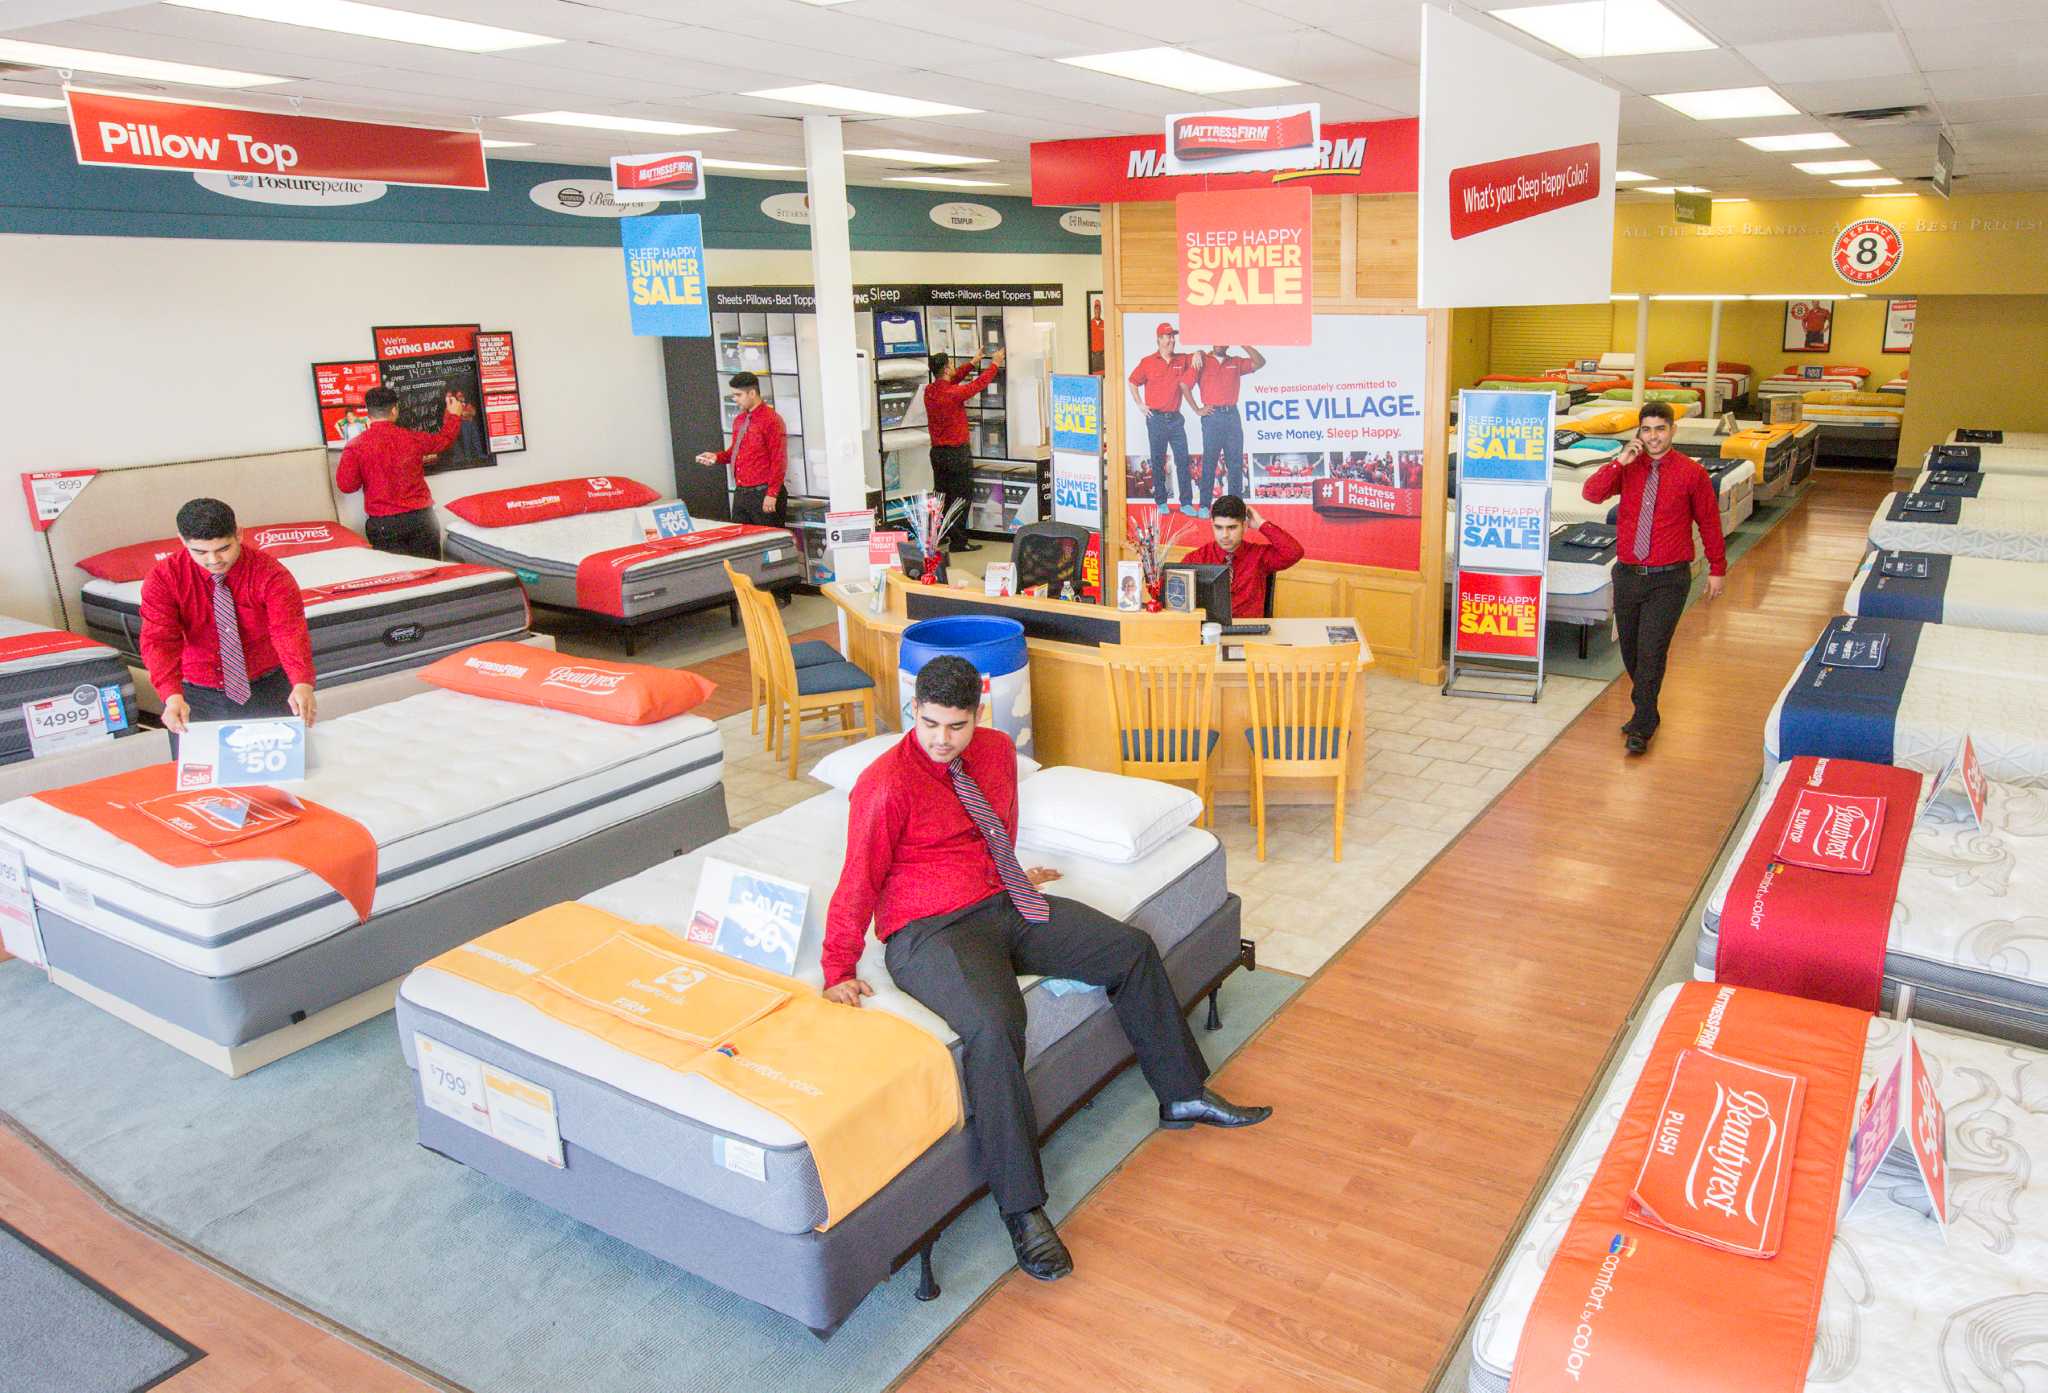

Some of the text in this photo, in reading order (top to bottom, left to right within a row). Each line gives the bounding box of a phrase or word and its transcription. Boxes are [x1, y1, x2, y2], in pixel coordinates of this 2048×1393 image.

[98, 120, 299, 171] Pillow Top
[1463, 162, 1589, 213] What's your Sleep Happy Color?
[1656, 224, 1687, 237] THE
[1695, 224, 1736, 236] BEST
[1743, 223, 1808, 236] BRANDS
[1915, 218, 1961, 232] BEST
[1186, 228, 1303, 248] SLEEP HAPPY
[1842, 225, 1895, 245] REPLACE
[628, 245, 697, 261] SLEEP HAPPY
[1186, 244, 1302, 269] SUMMER
[1855, 236, 1879, 265] 8
[630, 258, 700, 278] SUMMER
[1841, 263, 1882, 280] EVERY
[631, 276, 702, 306] SALE
[869, 287, 900, 302] Sleep
[931, 289, 955, 301] Sheets
[957, 289, 982, 301] Pillows
[984, 290, 1000, 301] Bed
[1002, 290, 1032, 302] Toppers
[1185, 267, 1303, 306] SALE
[716, 293, 817, 308] Sheets Pillows Bed Topp
[382, 336, 407, 346] We're
[384, 339, 455, 356] GIVING BACK!
[1254, 380, 1397, 394] We're passionately committed to
[1054, 403, 1097, 415] SUMMER
[1245, 395, 1421, 422] RICE VILLAGE.
[1055, 415, 1097, 434] SALE
[1467, 415, 1545, 426] SLEEP HAPPY
[1257, 427, 1402, 441] Save Money. Sleep Happy.
[1467, 425, 1544, 439] SUMMER
[1467, 437, 1545, 461] SALE
[1056, 477, 1097, 492] SUMMER
[1348, 482, 1396, 500] Mattress
[1056, 490, 1098, 511] SALE
[1348, 494, 1396, 511] Retailer
[660, 510, 686, 522] SAVE
[1464, 504, 1542, 516] SLEEP HAPPY
[1464, 514, 1540, 529] SUMMER
[255, 526, 330, 546] Beautyrest
[830, 530, 840, 541] 6
[1463, 526, 1540, 550] SALE
[1461, 592, 1537, 605] SLEEP HAPPY
[1461, 601, 1536, 617] SUMMER
[1460, 614, 1536, 638] SALE
[36, 707, 89, 728] $4999
[182, 774, 210, 786] Sale
[1825, 804, 1864, 860] Beautyrest
[1750, 899, 1766, 929] color
[689, 925, 714, 940] Sale
[1699, 987, 1736, 1050] MATTRESSFIRM
[1655, 1109, 1686, 1156] PLUSH
[1702, 1085, 1768, 1218] Beautyrest
[1585, 1254, 1621, 1312] comfort
[1567, 1319, 1599, 1382] color
